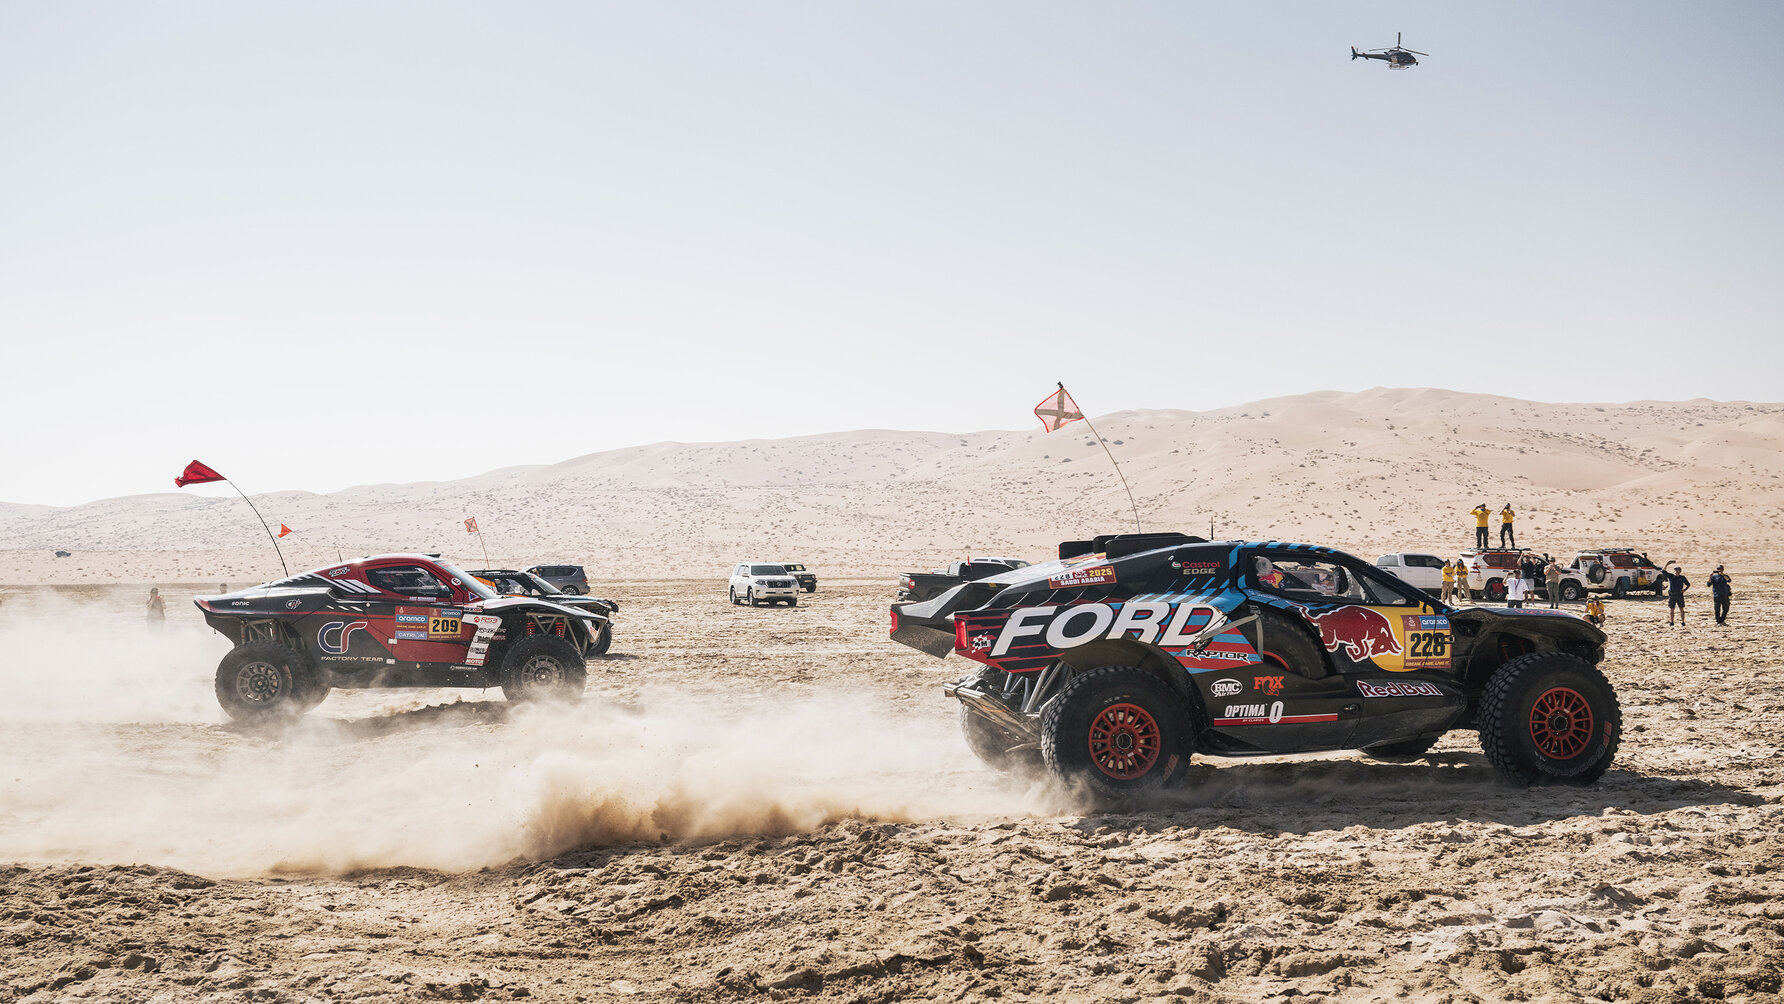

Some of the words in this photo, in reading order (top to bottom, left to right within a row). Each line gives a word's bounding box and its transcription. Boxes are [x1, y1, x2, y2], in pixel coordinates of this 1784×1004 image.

[1088, 567, 1113, 577] 2025
[1182, 561, 1221, 569] Castrol
[1081, 576, 1105, 584] ARABIA
[432, 619, 459, 633] 209
[990, 602, 1228, 657] FORD
[1410, 632, 1446, 657] 228
[1185, 649, 1252, 664] RAPTOR
[1214, 683, 1240, 692] BMC
[1253, 676, 1285, 694] FOX
[1356, 680, 1404, 698] Red
[1396, 682, 1444, 696] Bull
[1224, 703, 1266, 718] OPTIMA
